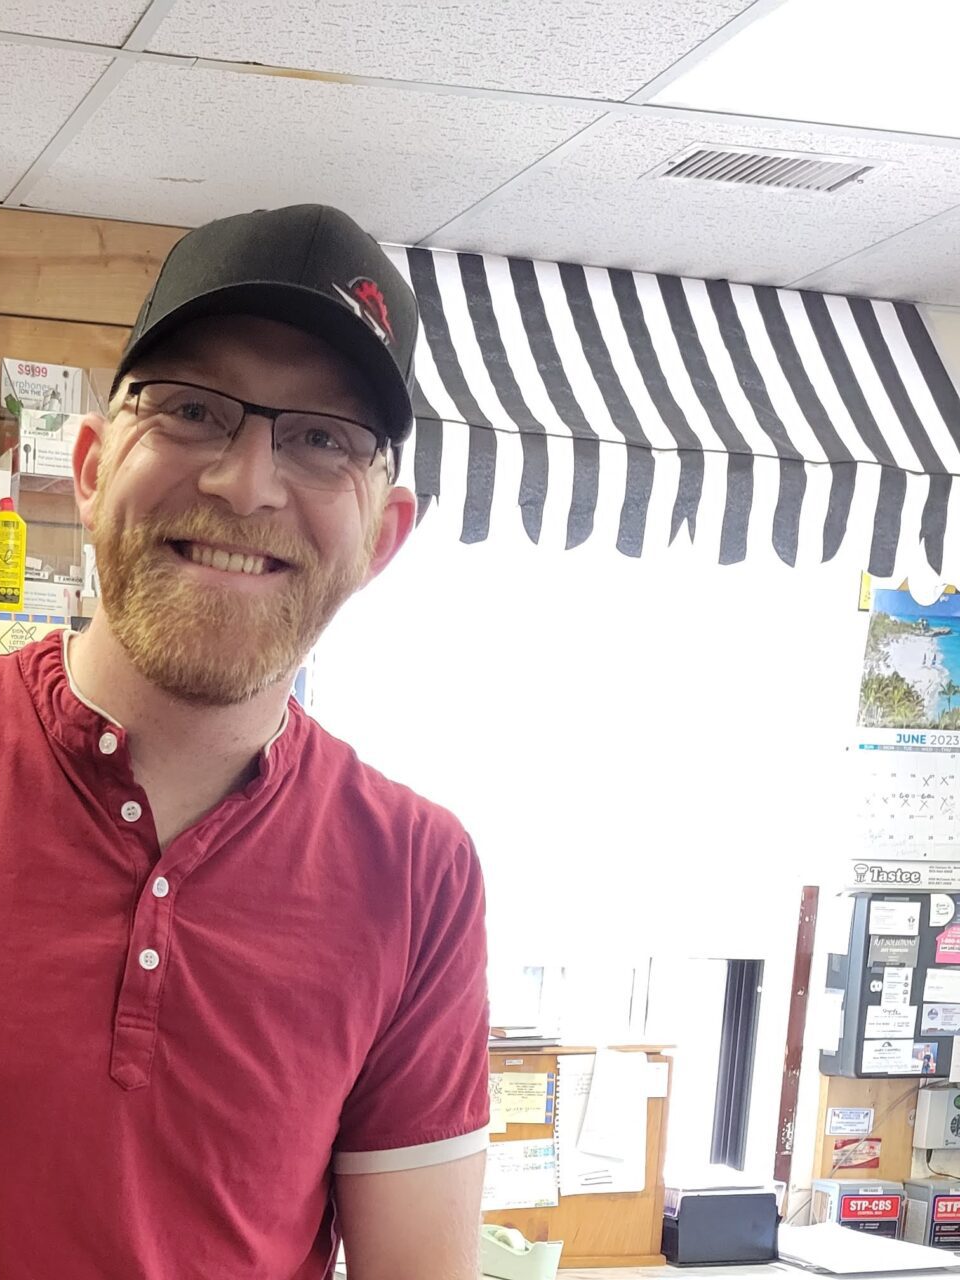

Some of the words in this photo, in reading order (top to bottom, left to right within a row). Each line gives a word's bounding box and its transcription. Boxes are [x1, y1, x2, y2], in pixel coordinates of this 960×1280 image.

[896, 733, 927, 744] JUNE
[930, 735, 960, 746] 2023
[870, 866, 922, 883] Tastee
[850, 1200, 891, 1211] STP-CBS
